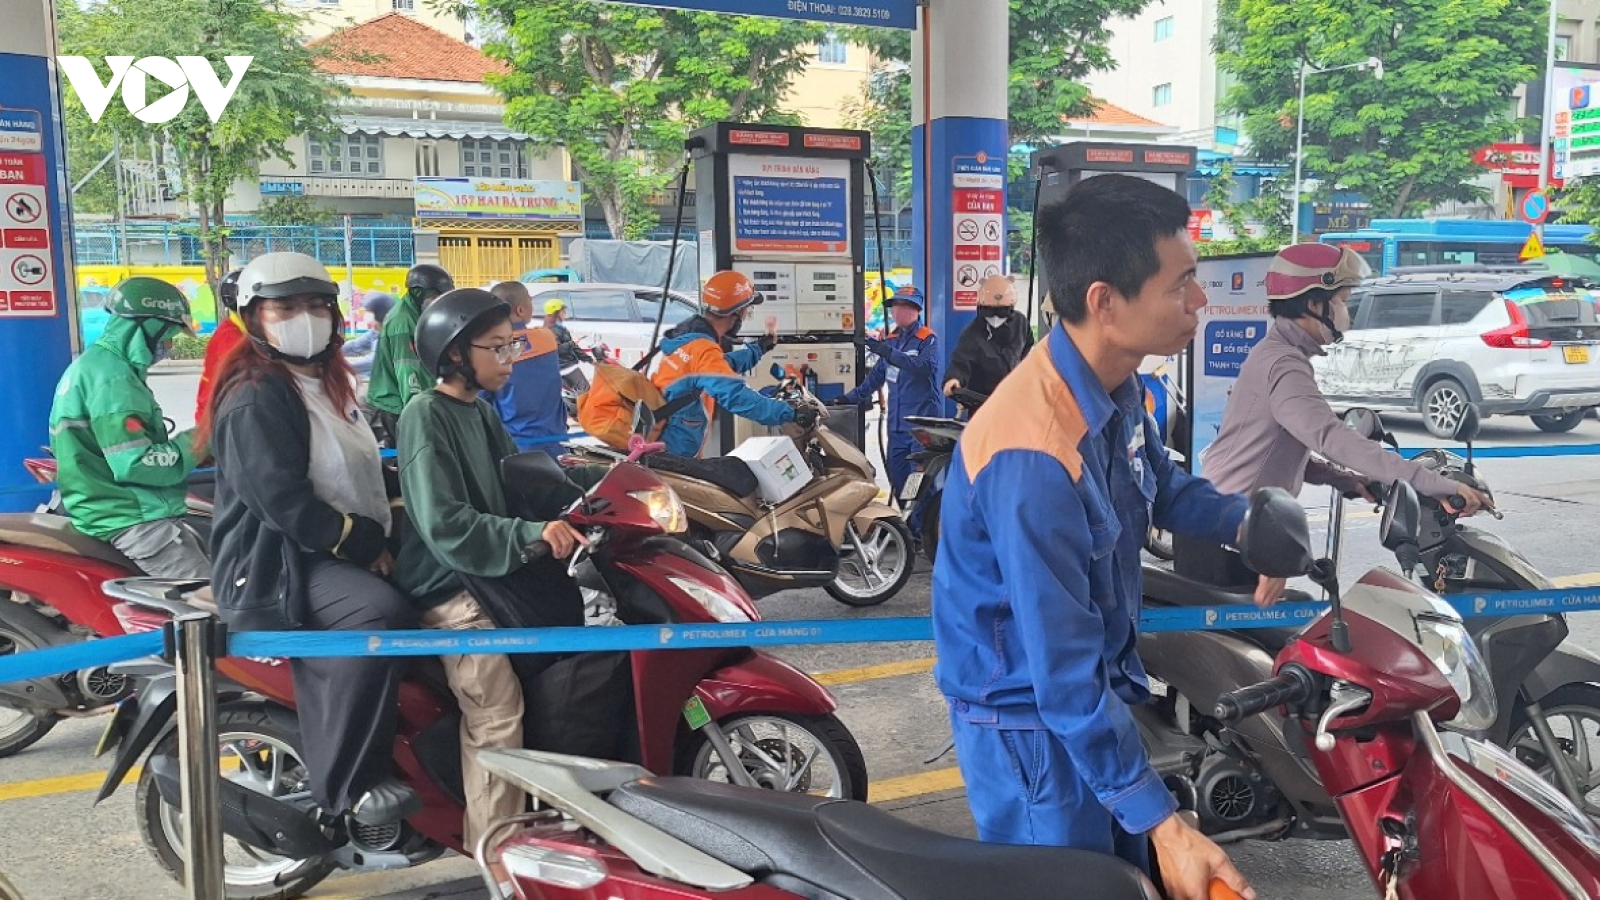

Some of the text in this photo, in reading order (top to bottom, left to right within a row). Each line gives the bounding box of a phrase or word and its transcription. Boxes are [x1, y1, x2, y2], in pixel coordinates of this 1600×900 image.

[787, 1, 807, 14] ĐIỆN
[0, 170, 24, 182] BẠN
[455, 195, 474, 206] 157
[477, 196, 500, 206] HAI
[1204, 306, 1258, 314] PETROLIMEX
[838, 364, 852, 374] 22
[1209, 361, 1230, 369] THANH
[142, 448, 179, 468] Grab
[1495, 598, 1554, 610] PETROLIMEX
[1562, 594, 1582, 606] CỬA
[1226, 611, 1287, 621] PETROLIMEX
[683, 629, 746, 640] PETROLIMEX
[391, 638, 460, 648] PETROLIMEX
